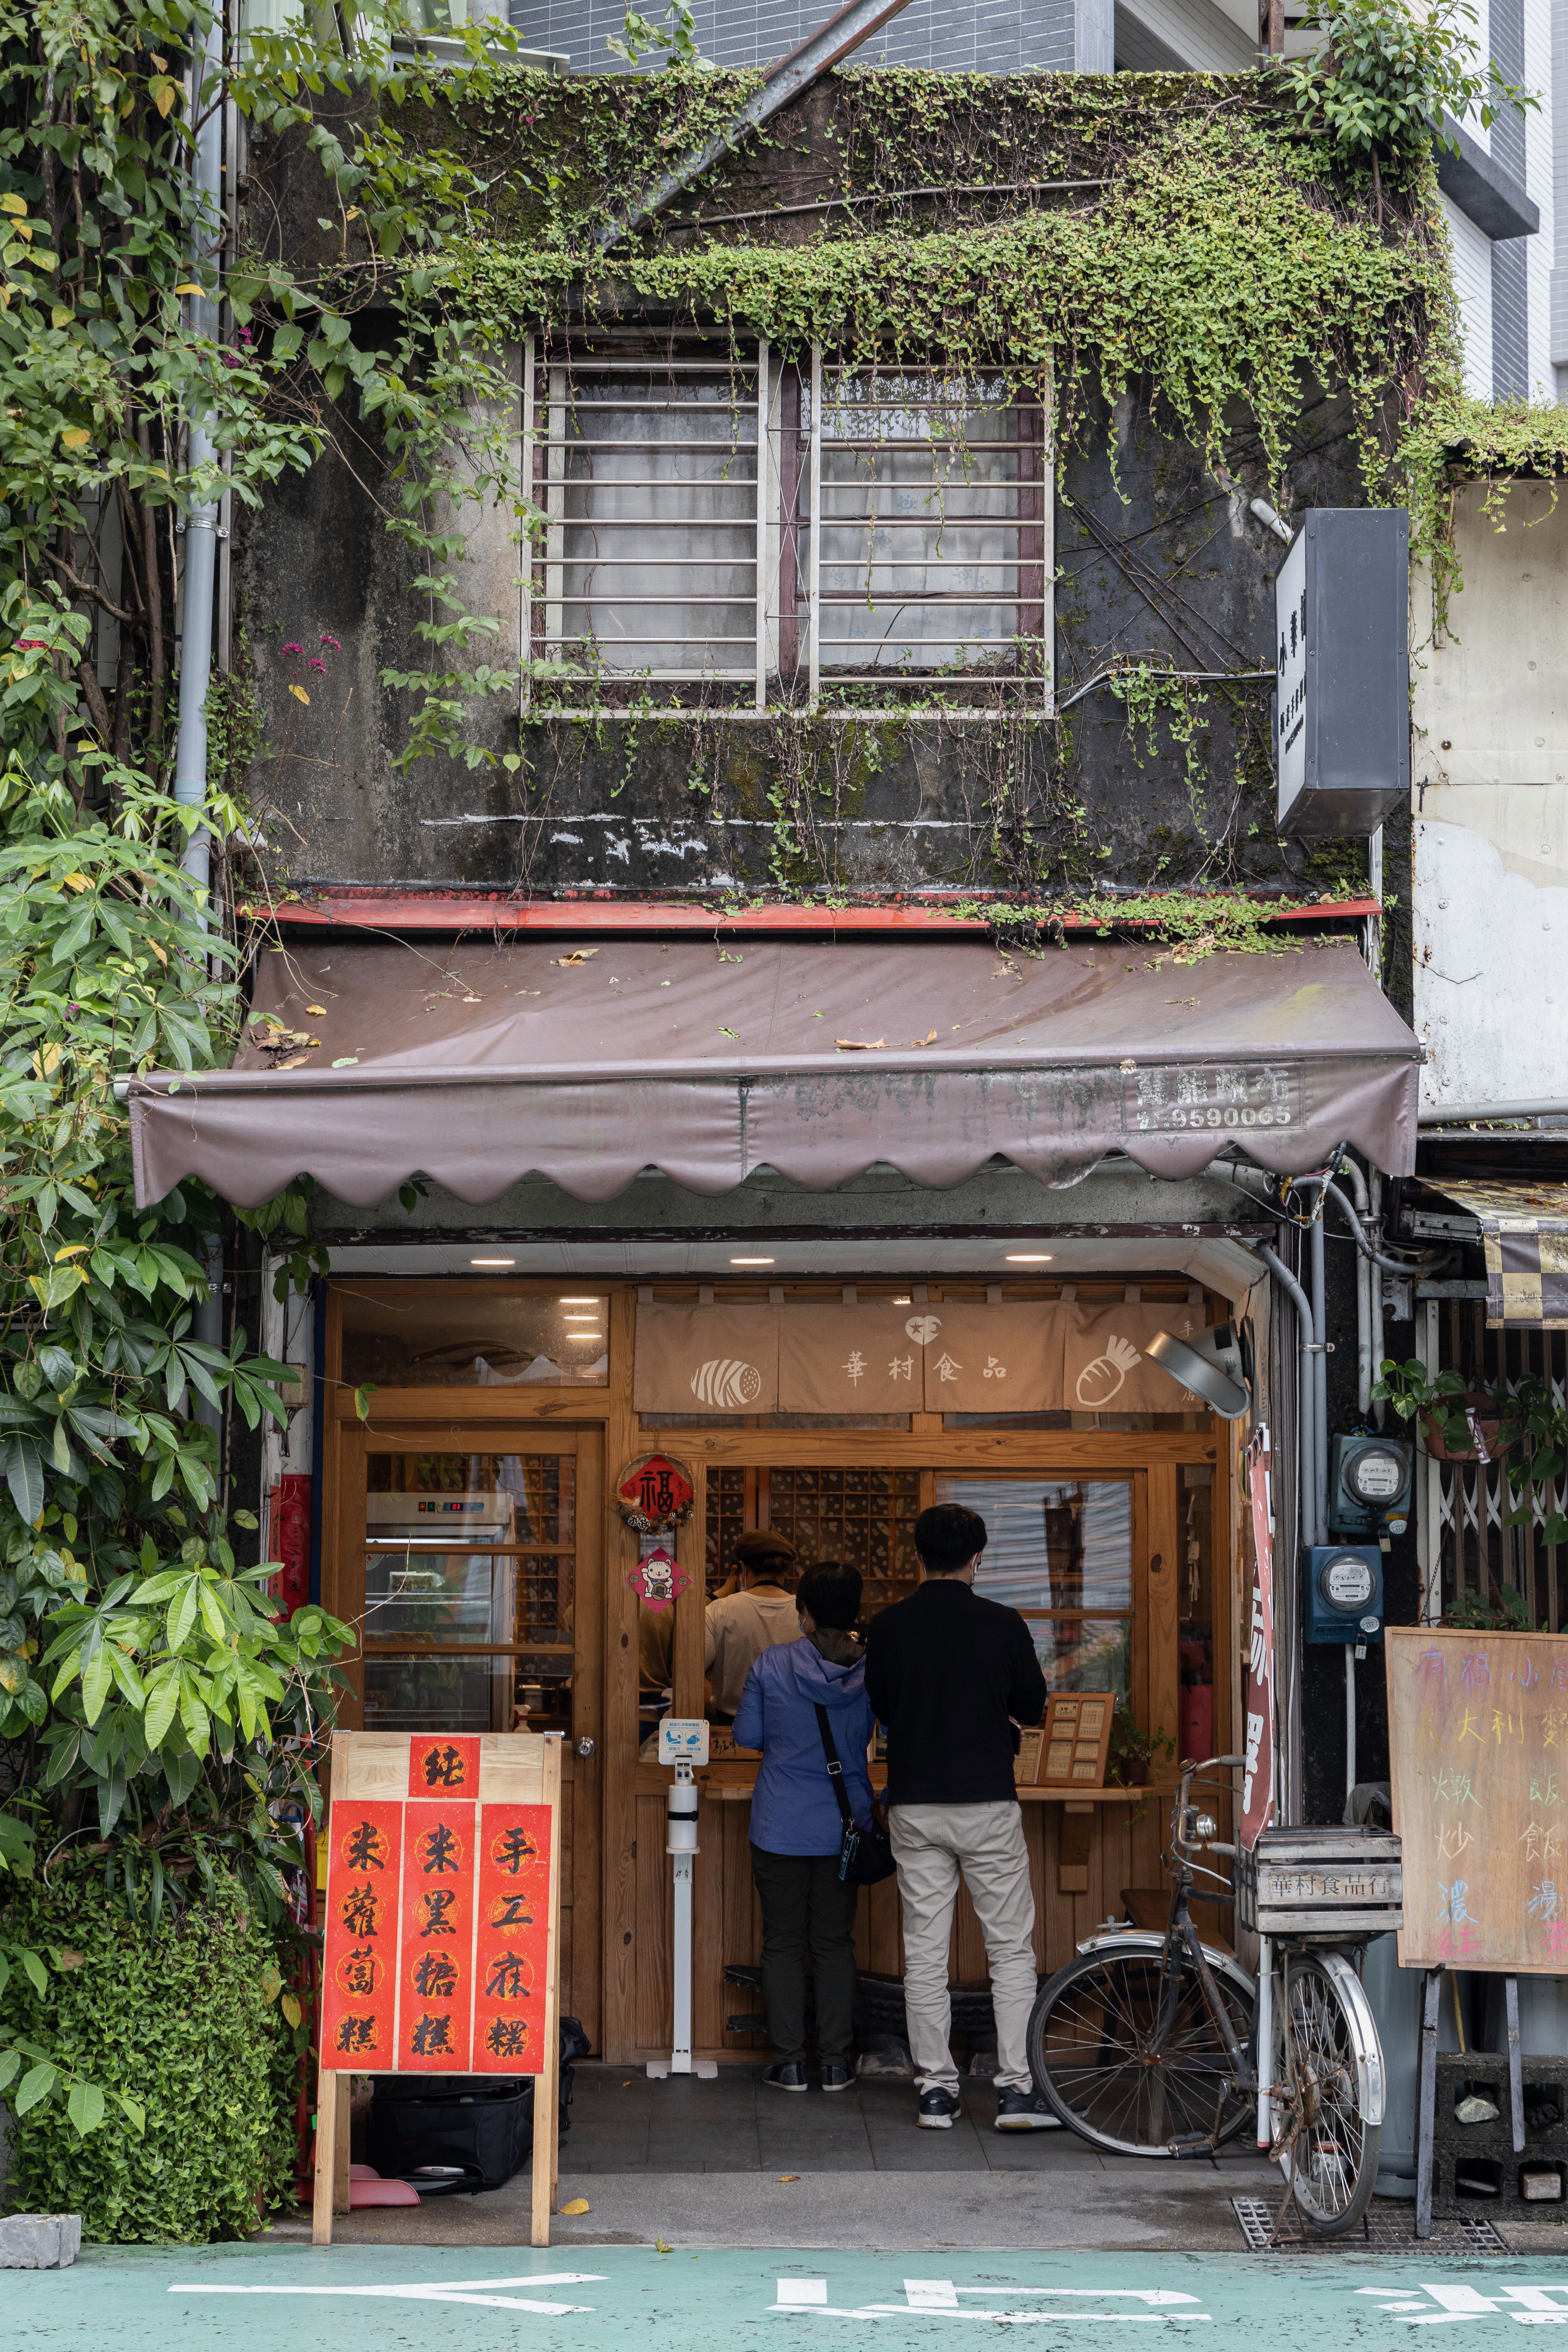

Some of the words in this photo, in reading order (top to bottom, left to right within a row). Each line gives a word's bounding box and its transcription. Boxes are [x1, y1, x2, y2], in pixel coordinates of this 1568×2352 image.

[841, 1350, 1006, 1387] 華村食品
[639, 1470, 675, 1514] 福
[1419, 1704, 1568, 1750] 大利麵
[424, 1746, 466, 1788] 純
[1435, 1821, 1561, 1863] 炒飯
[1271, 1875, 1389, 1897] 華村食品行
[1436, 1879, 1564, 1923] 濃湯
[411, 1823, 459, 2055] 米黑糖糕
[1438, 1918, 1568, 1958] 紅茶
